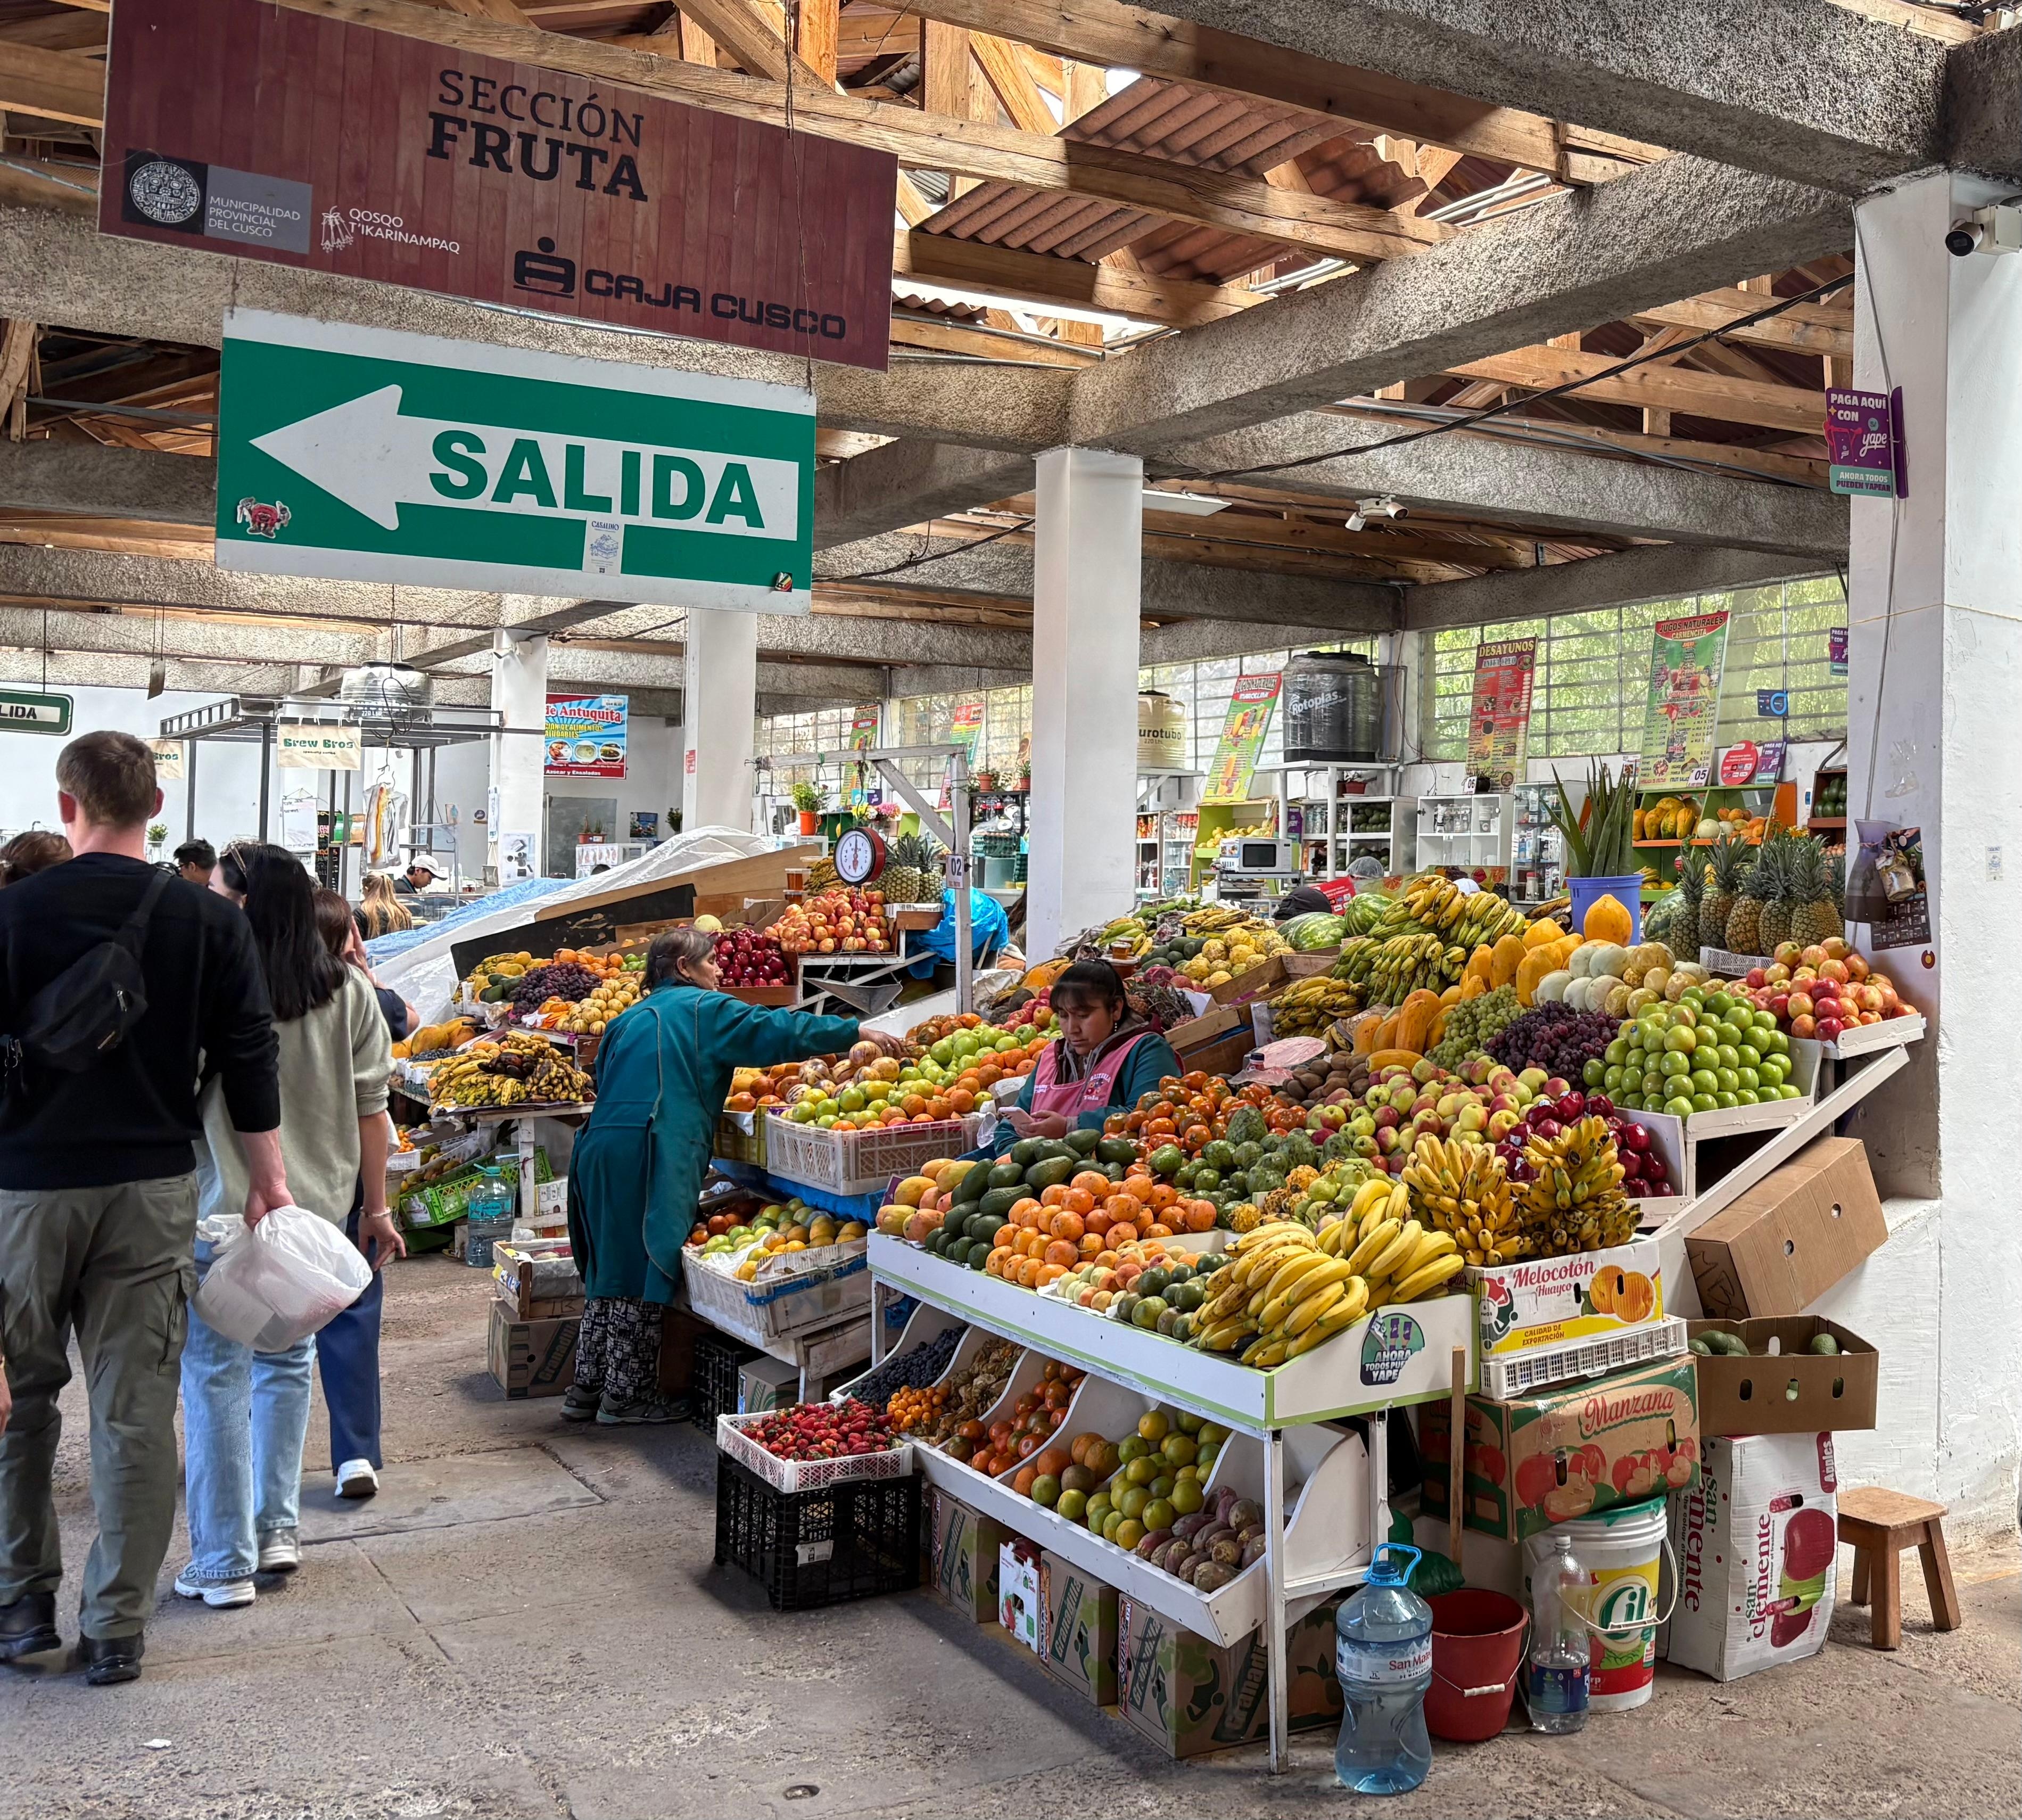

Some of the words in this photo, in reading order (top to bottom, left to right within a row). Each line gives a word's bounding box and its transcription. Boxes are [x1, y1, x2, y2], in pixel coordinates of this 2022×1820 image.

[438, 69, 644, 146] SECCIÓN
[426, 111, 648, 202] FRUTA
[210, 196, 300, 221] MUNICIPALIDAD
[209, 208, 277, 228] PROVINCIAL
[349, 208, 403, 228] QOSQO
[209, 218, 229, 229] DEL
[232, 223, 273, 237] CUSCO
[584, 268, 700, 314] CAJA
[710, 293, 846, 340] CUSCO
[1830, 393, 1859, 406] PAGA
[1861, 397, 1887, 409] AQUÍ
[1837, 410, 1859, 422] CON
[1859, 433, 1887, 457] yape
[429, 430, 764, 529] SALIDA
[1836, 480, 1863, 489] PUEDEN
[1865, 482, 1891, 492] YAPEAR
[1839, 472, 1864, 480] AHORA
[1865, 474, 1888, 483] TODOS
[1660, 623, 1682, 632] JUGOS
[1683, 616, 1723, 628] NATURALES
[1671, 628, 1706, 639] CARMENCITA
[1479, 640, 1534, 657] DESAYUNOS
[560, 705, 622, 723] Antuquita
[570, 724, 604, 732] ALIMENTOS
[283, 738, 318, 748] Brew
[323, 739, 353, 748] Bros
[1694, 770, 1707, 780] 05
[1467, 779, 1475, 789] 06
[951, 857, 962, 876] 02
[1513, 1257, 1596, 1289] Melocotón
[1536, 1283, 1573, 1297] Huayco
[1522, 1330, 1565, 1346] EXPORTACIÓN
[1524, 1326, 1552, 1338] CALIDAD
[1375, 1349, 1411, 1363] AHORA
[1365, 1362, 1390, 1372] TODOS
[1584, 1391, 1674, 1432] Manzana
[1705, 1477, 1717, 1526] san
[1749, 1513, 1771, 1638] clemente
[1745, 1584, 1756, 1618] san
[1389, 1660, 1411, 1671] San
